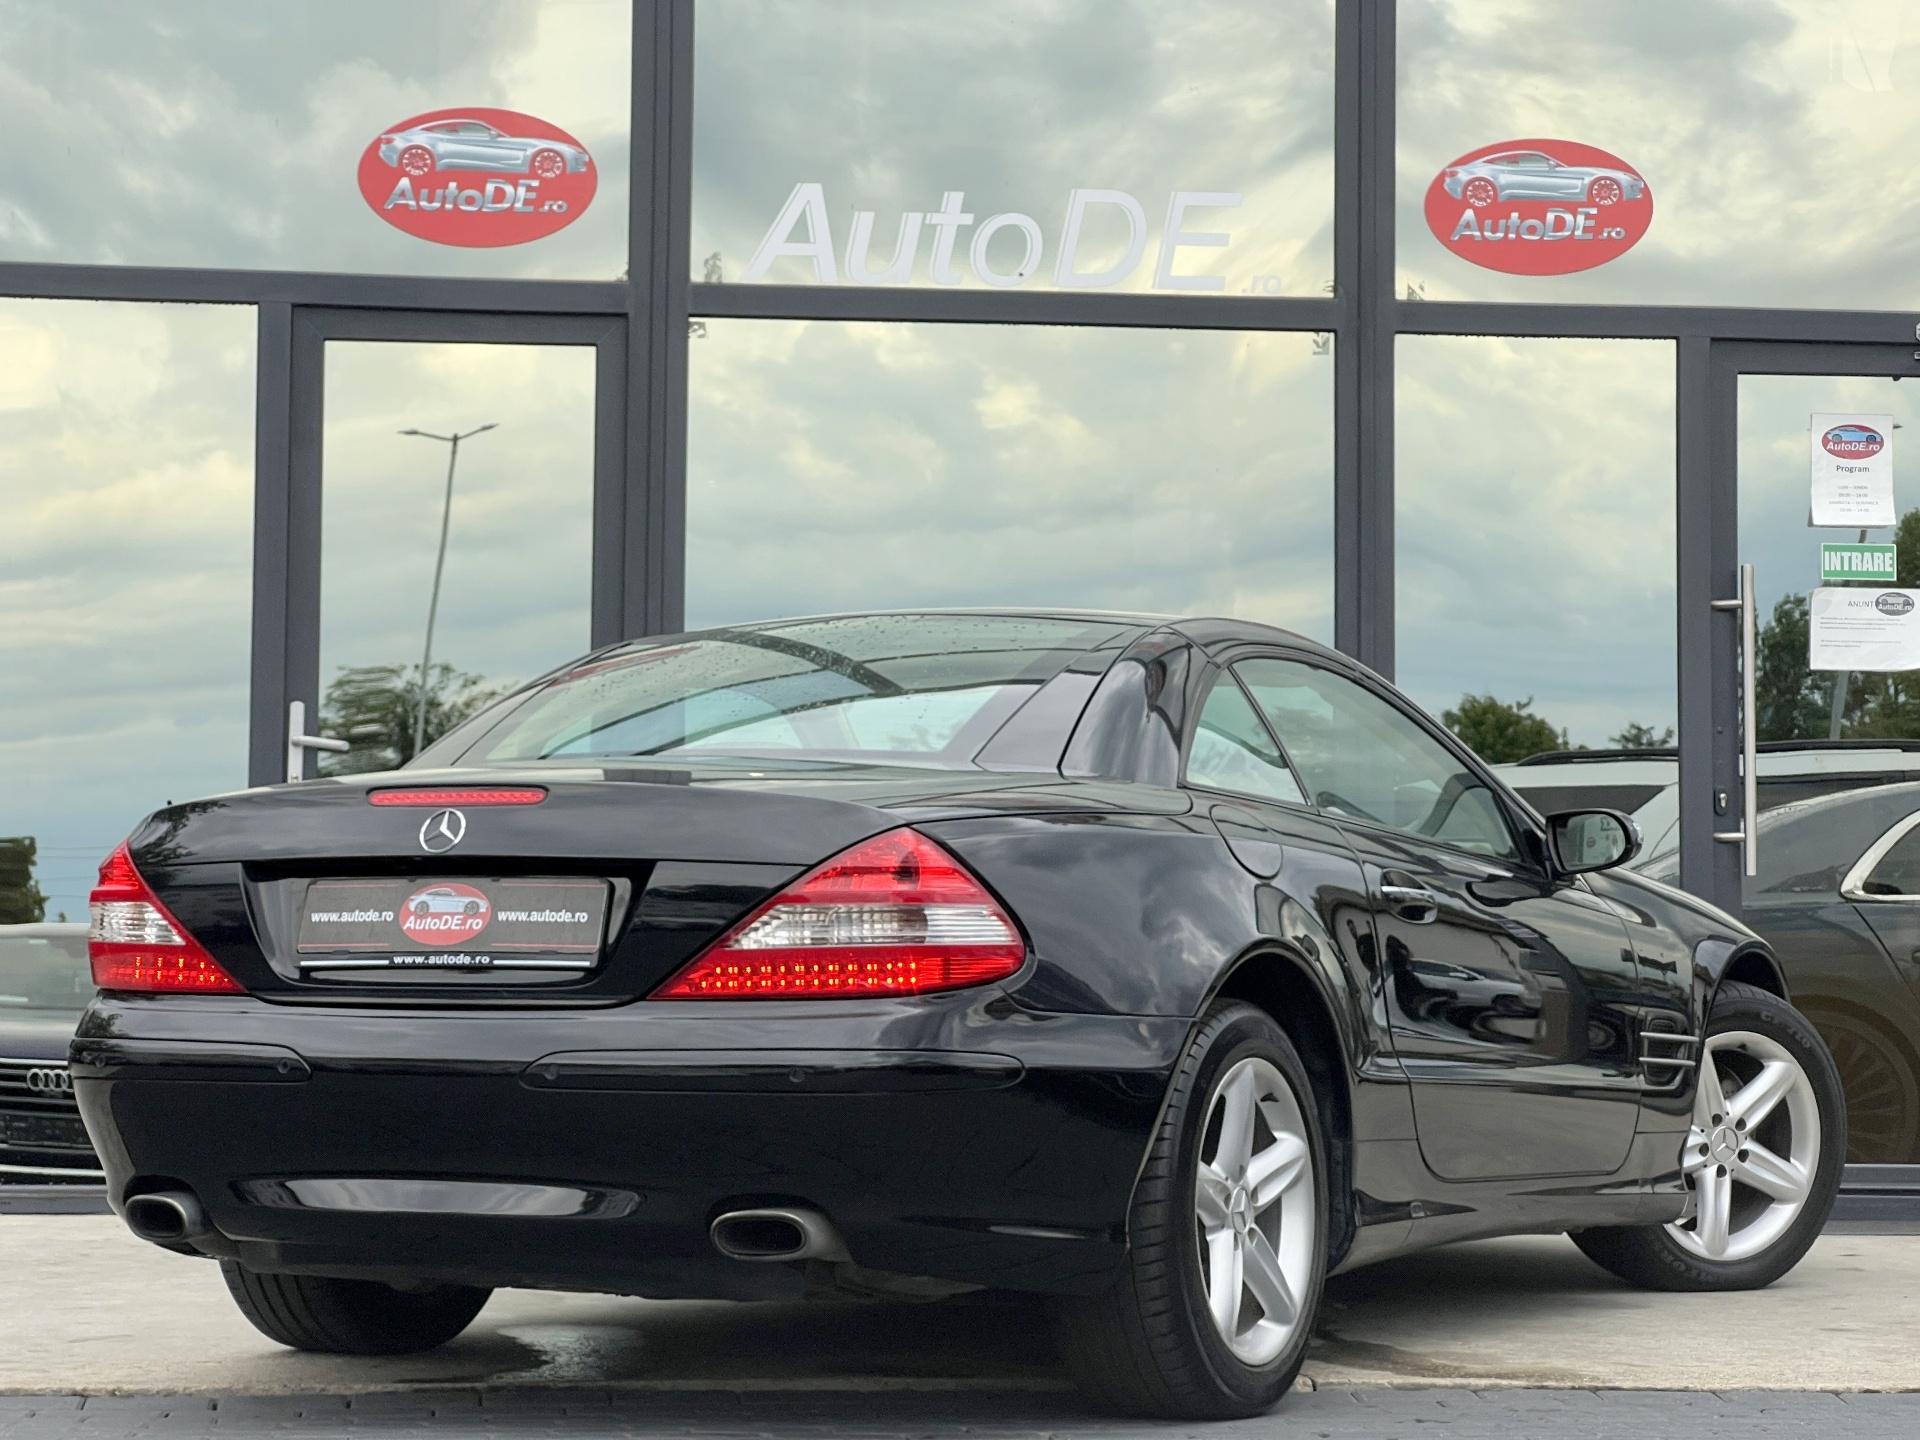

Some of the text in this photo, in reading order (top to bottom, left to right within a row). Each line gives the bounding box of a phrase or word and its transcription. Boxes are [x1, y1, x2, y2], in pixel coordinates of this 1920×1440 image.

[384, 176, 568, 214] AutoDE.ro
[1450, 207, 1626, 241] AutoDE.ro
[1826, 441, 1880, 451] AutoDE.ro
[1836, 465, 1870, 473] Program
[1824, 551, 1893, 572] INTRARE
[311, 909, 394, 923] www.autode.ro
[403, 915, 483, 931] AutoDE.ro
[497, 909, 588, 923] www.autode.ro
[393, 953, 490, 965] www.autode.ro
